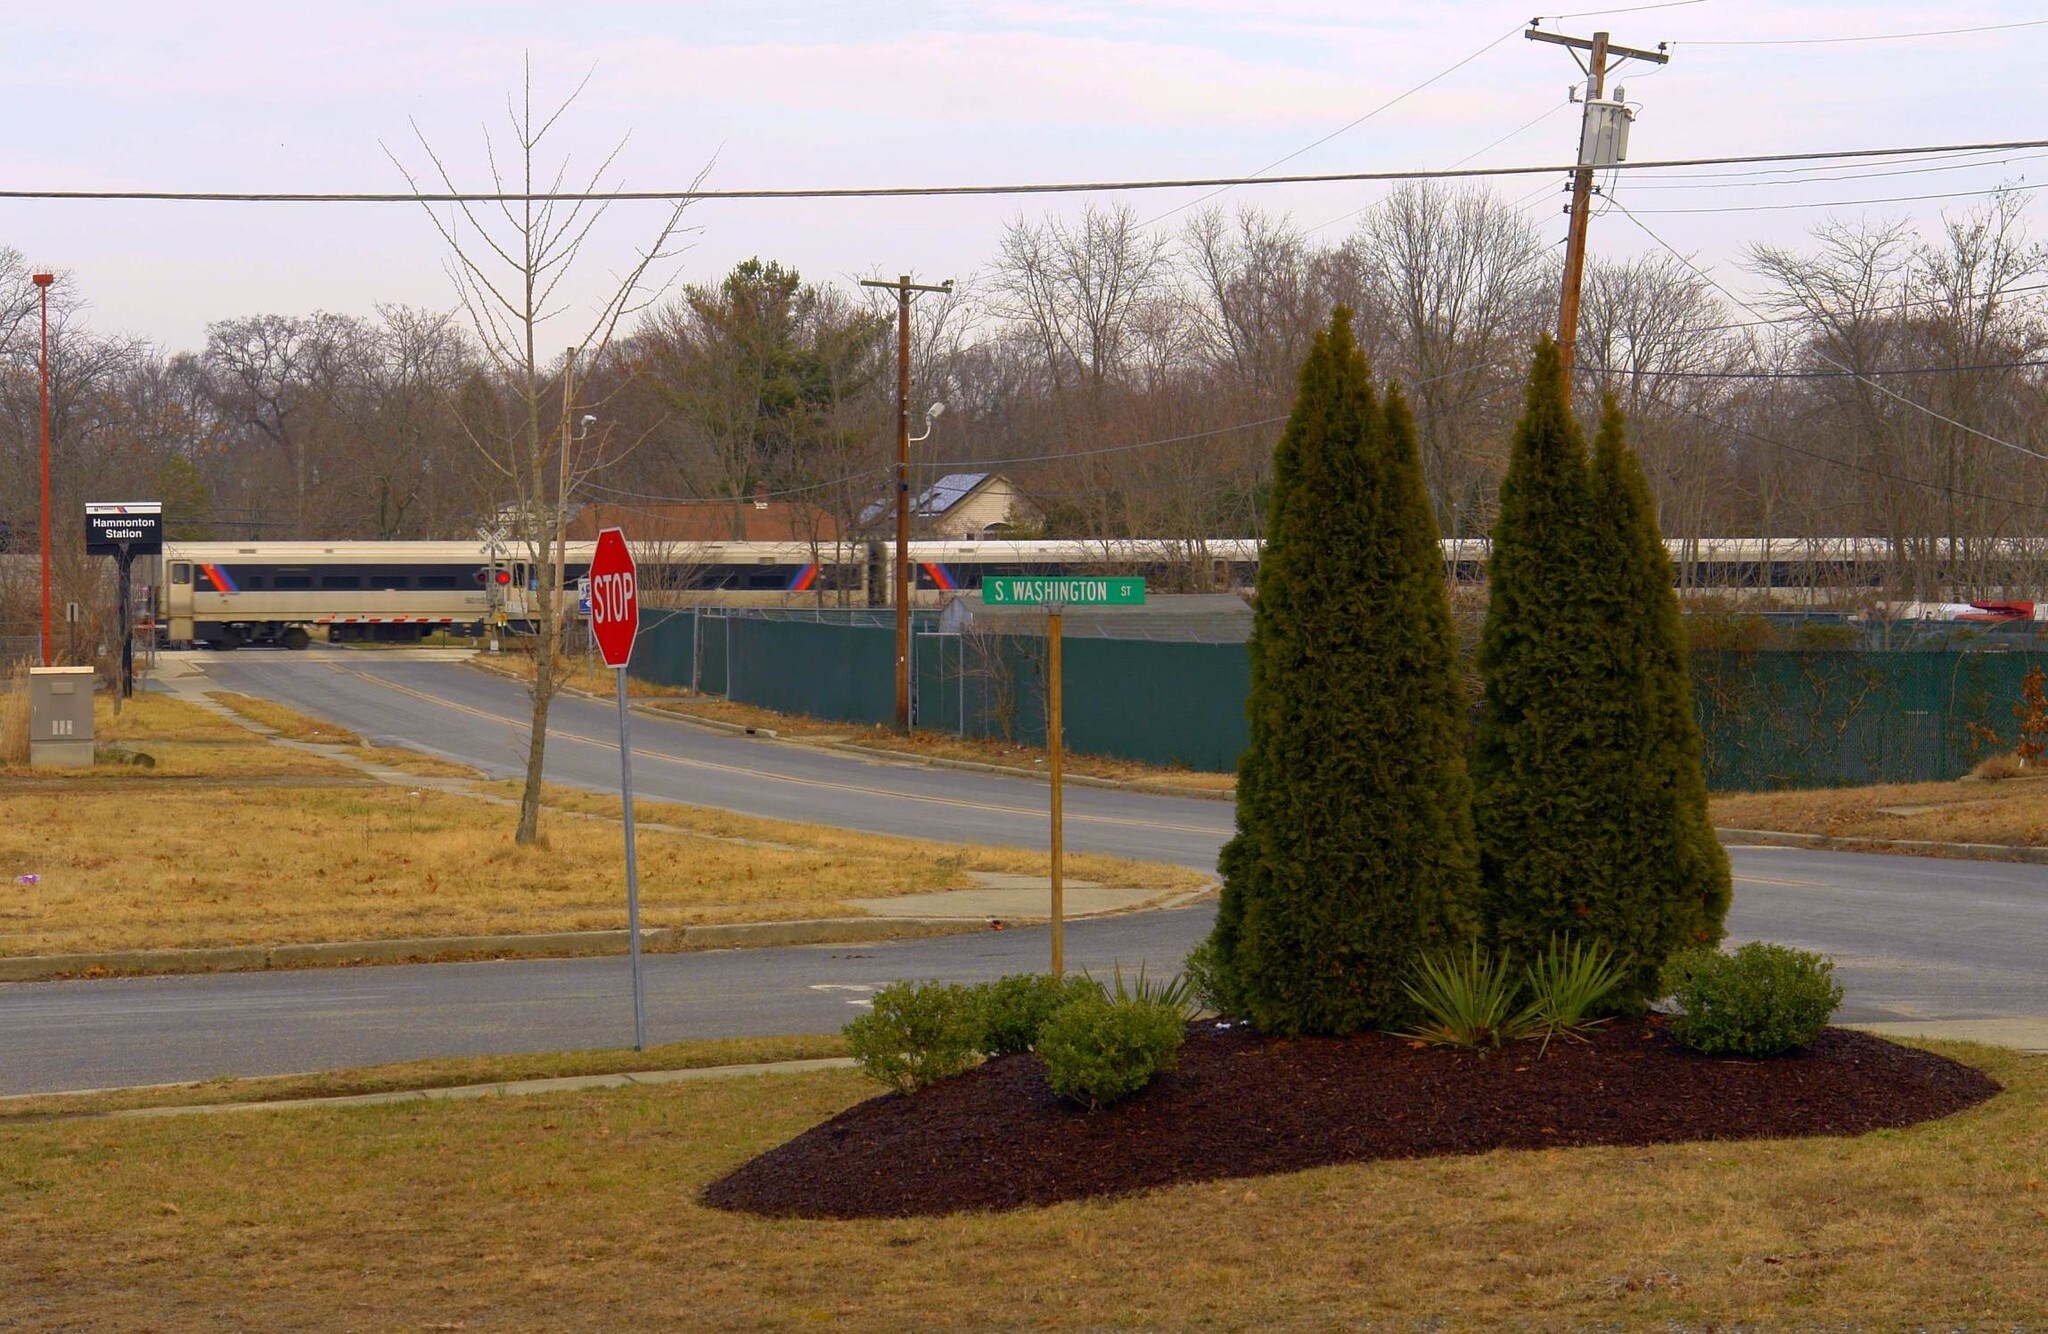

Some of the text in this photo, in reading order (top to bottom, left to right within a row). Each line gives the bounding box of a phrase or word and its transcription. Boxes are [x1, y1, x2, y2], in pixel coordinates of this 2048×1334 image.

[93, 518, 155, 528] Hammonton
[105, 529, 142, 538] Station
[594, 572, 633, 624] STOP
[995, 581, 1132, 601] S. WASHINGTON ST
